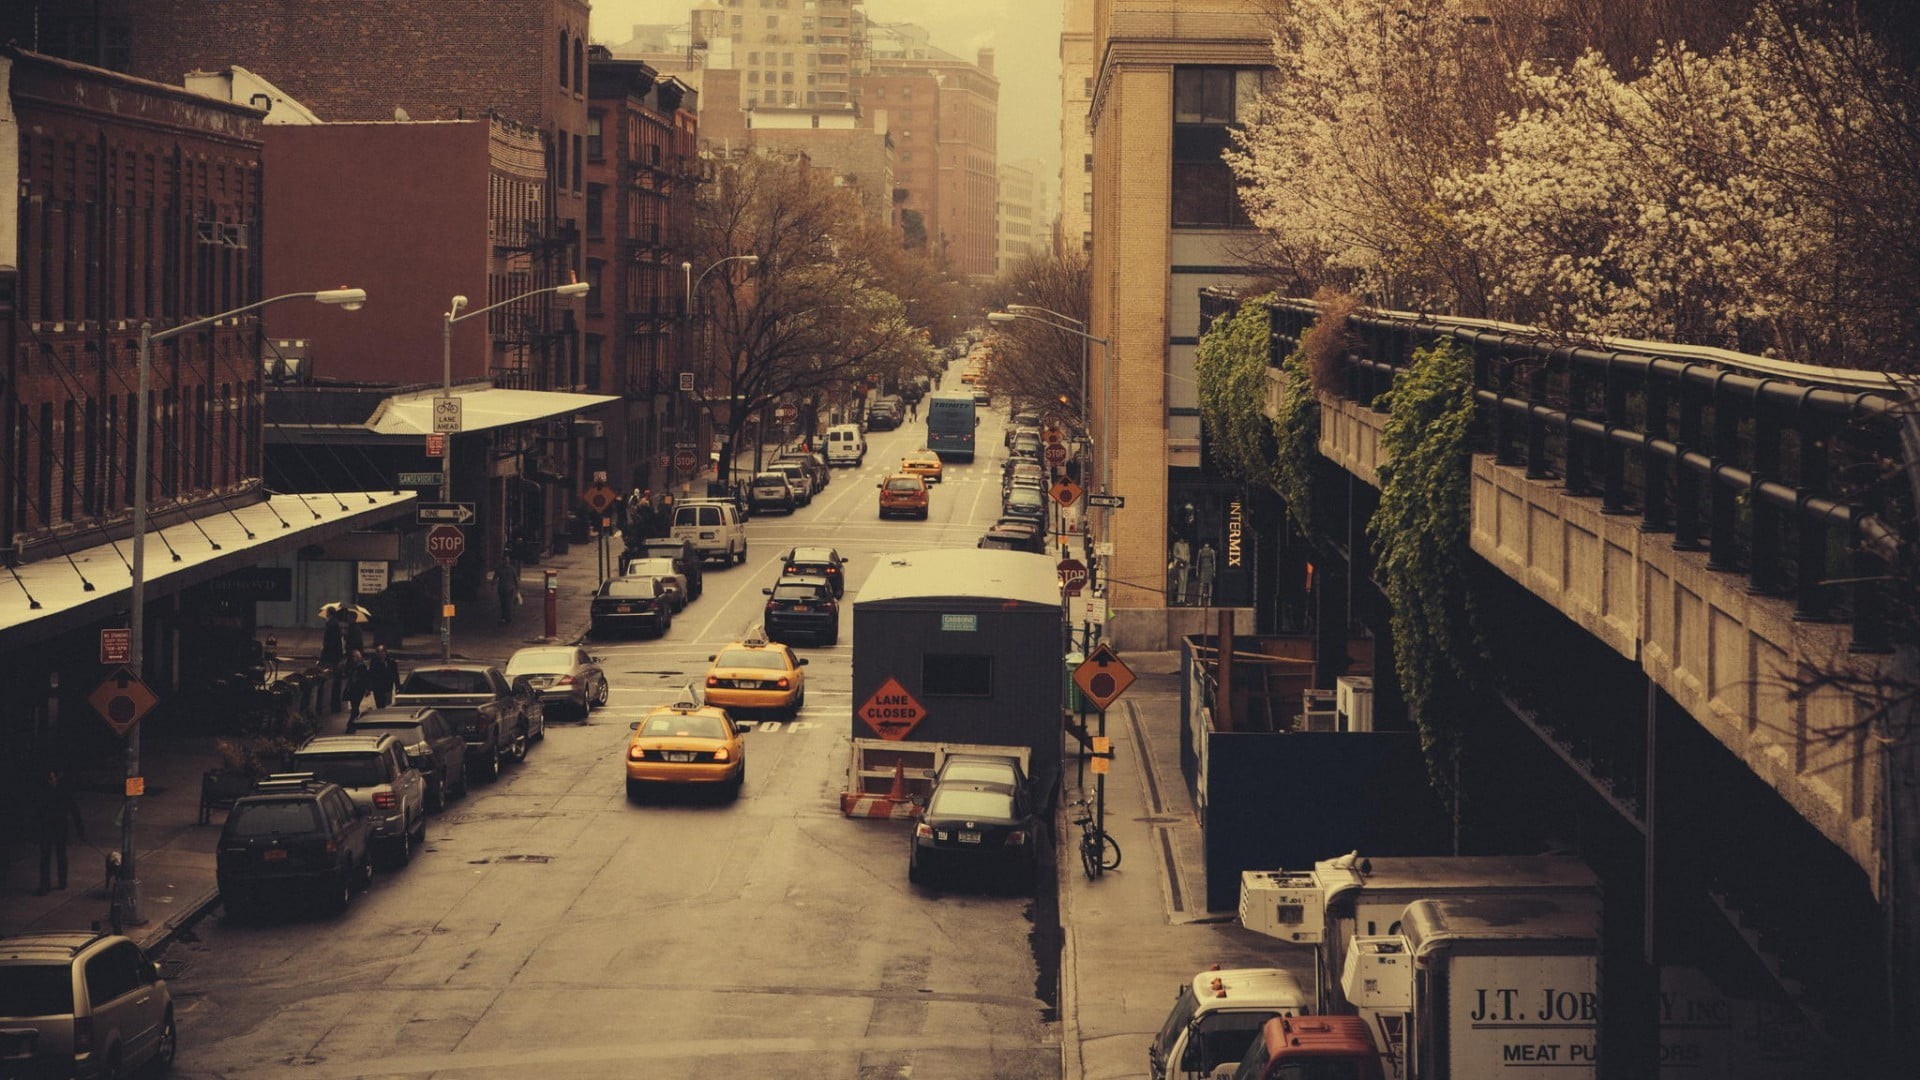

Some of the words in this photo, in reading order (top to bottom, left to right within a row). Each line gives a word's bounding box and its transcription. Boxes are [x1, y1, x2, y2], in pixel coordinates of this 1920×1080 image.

[1046, 449, 1065, 457] STOP
[676, 457, 696, 466] STOP
[425, 509, 438, 517] ONE
[453, 509, 468, 517] WAY
[1229, 502, 1241, 567] INTERMIX
[431, 536, 462, 550] STOP
[875, 696, 908, 705] LANE
[868, 708, 917, 718] CLOSED
[1471, 989, 1525, 1021] J.T.
[1503, 1044, 1561, 1061] MEAT
